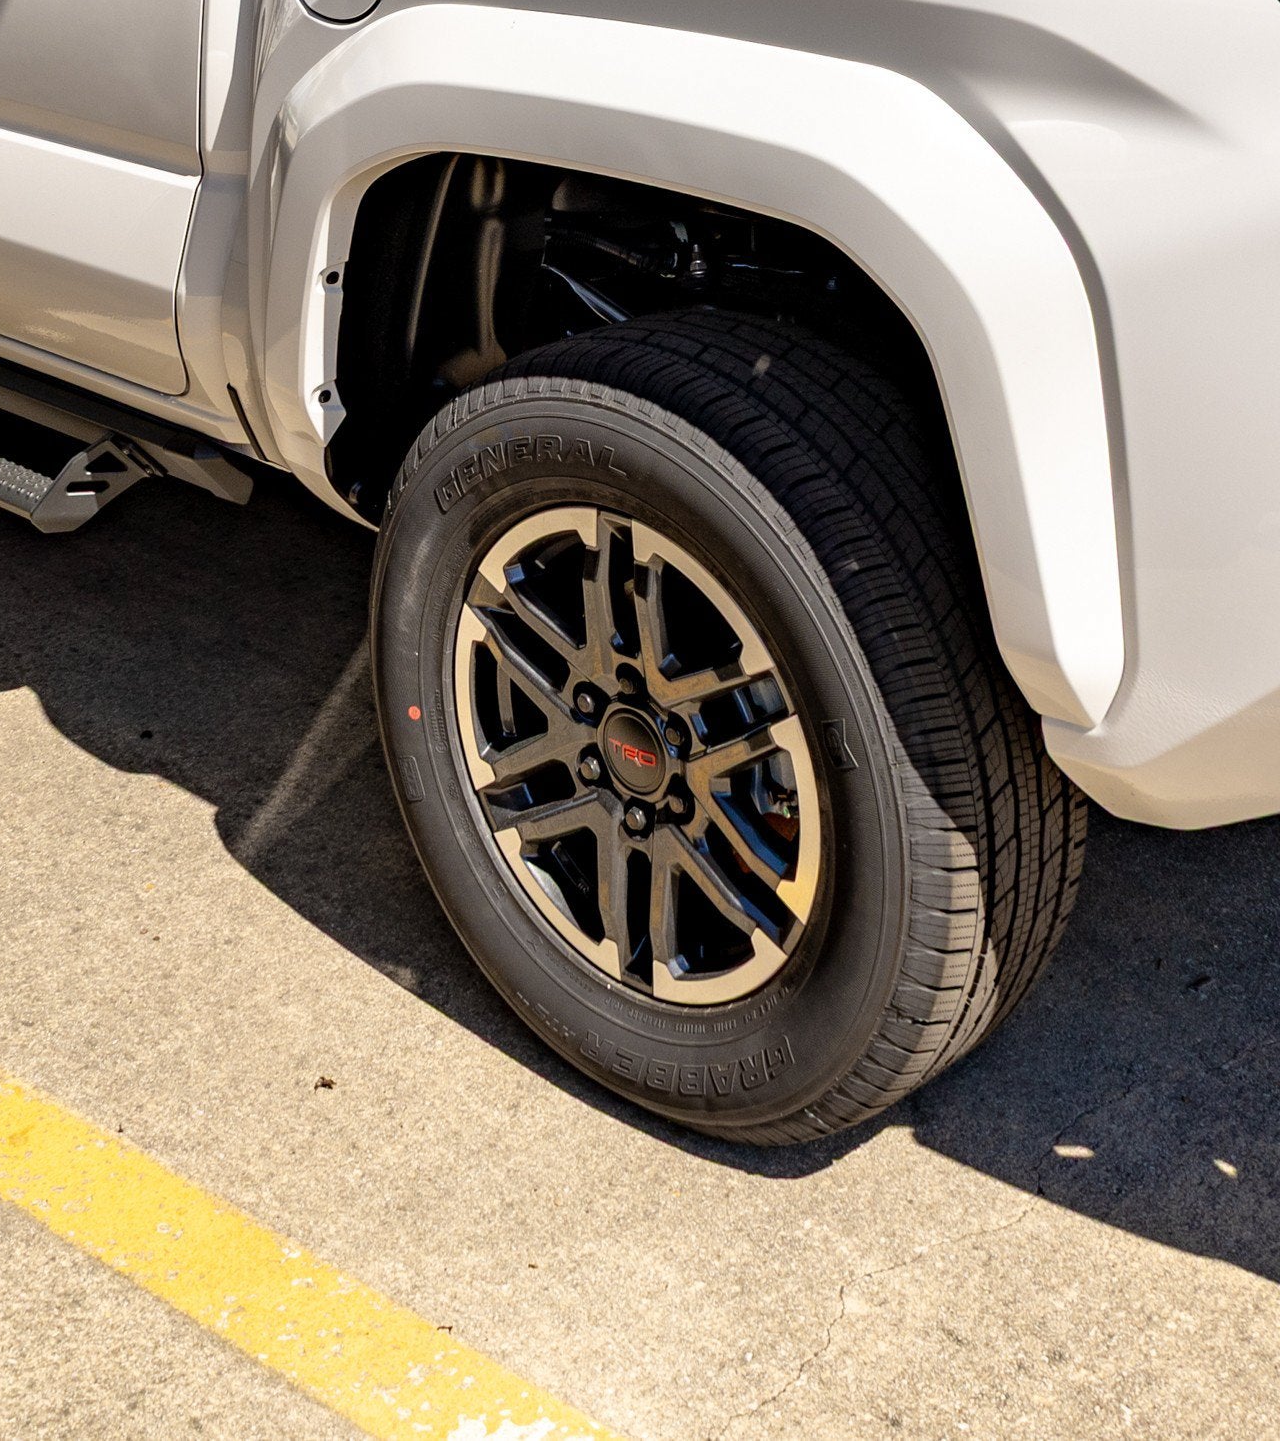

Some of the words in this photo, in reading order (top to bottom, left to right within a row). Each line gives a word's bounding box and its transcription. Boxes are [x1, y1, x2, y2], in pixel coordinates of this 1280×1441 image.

[434, 434, 628, 515] GENERAL
[609, 738, 657, 768] TRD
[580, 1030, 796, 1096] GRABBER
